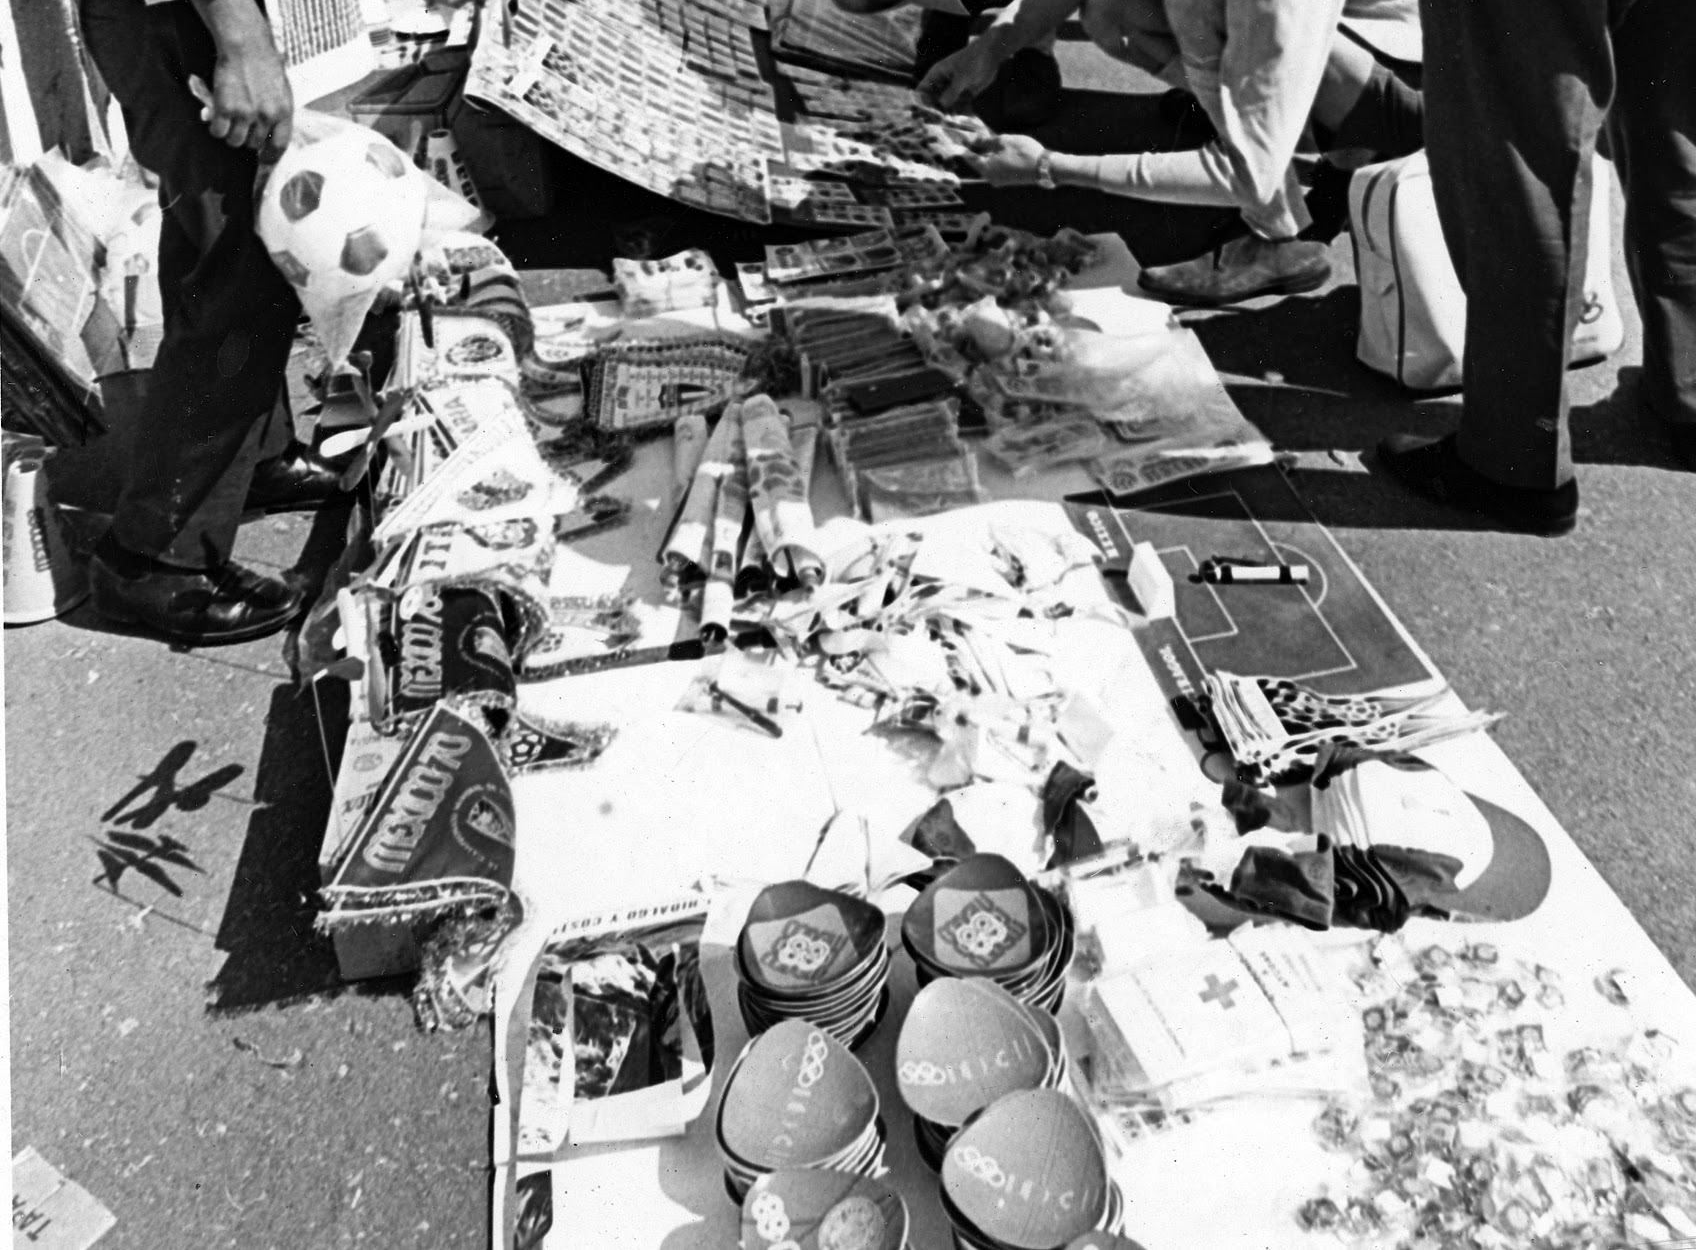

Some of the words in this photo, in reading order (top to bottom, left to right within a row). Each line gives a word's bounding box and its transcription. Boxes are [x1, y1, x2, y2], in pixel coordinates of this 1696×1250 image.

[363, 765, 453, 872] MEXICO
[418, 731, 473, 770] 70
[626, 899, 699, 920] HIDALGO
